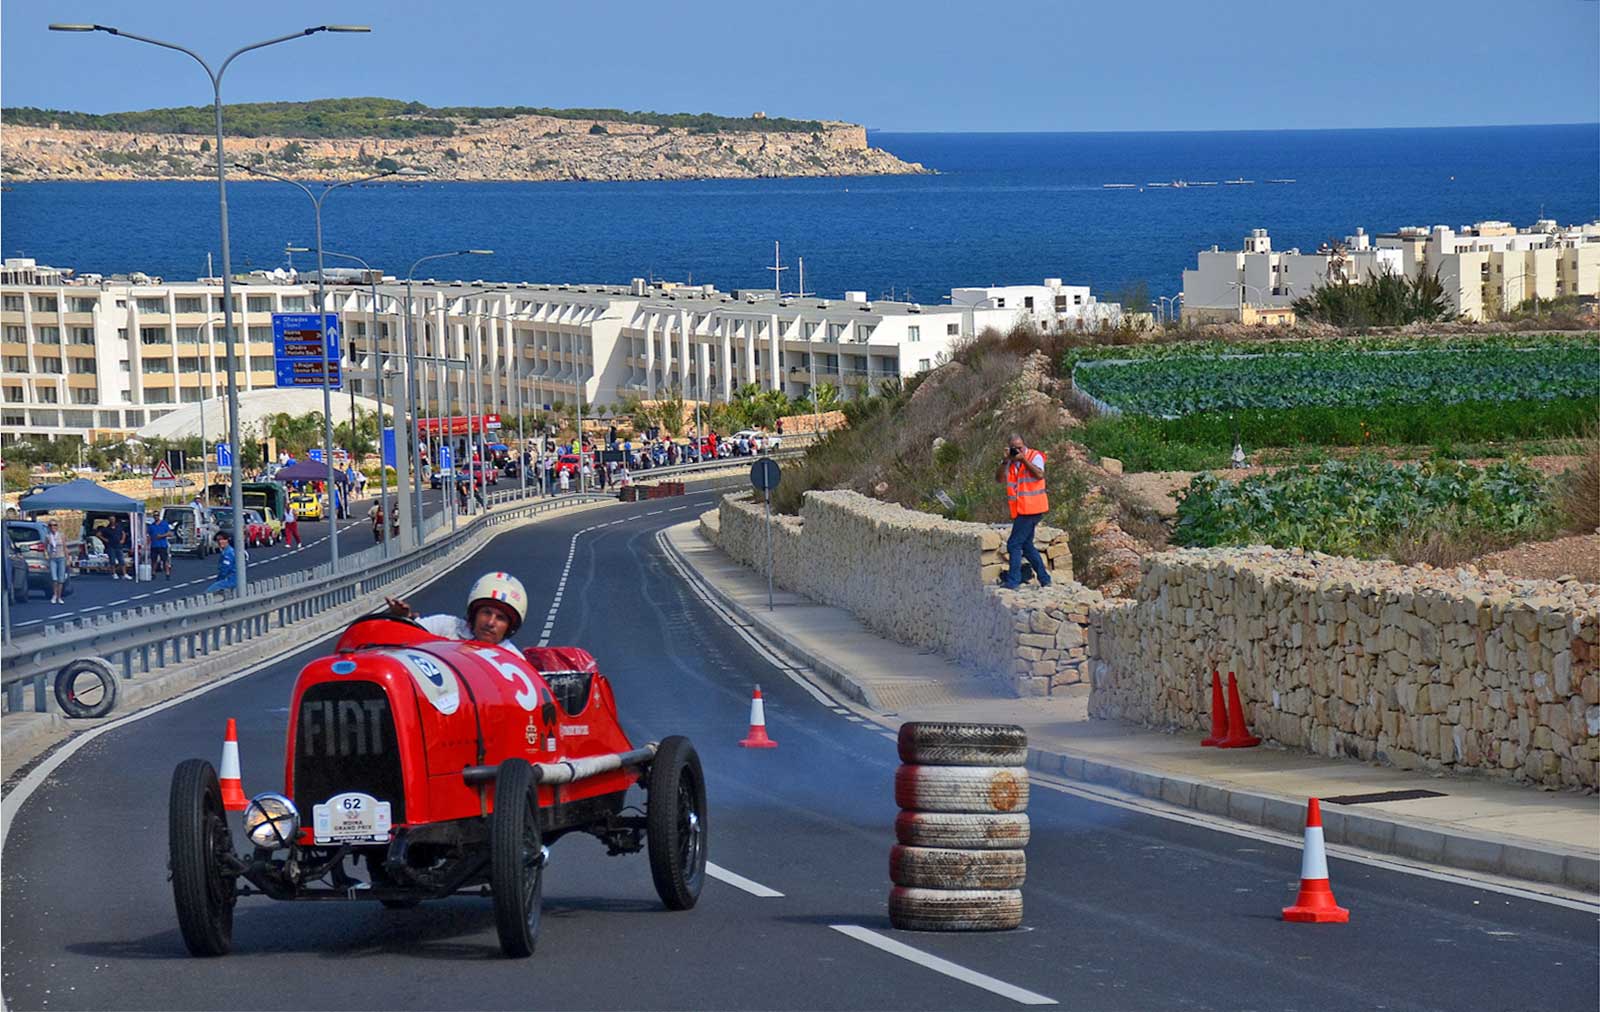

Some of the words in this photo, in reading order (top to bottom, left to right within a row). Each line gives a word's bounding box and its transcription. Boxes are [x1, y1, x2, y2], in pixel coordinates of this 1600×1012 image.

[474, 648, 538, 711] 5
[303, 699, 385, 757] FIAT
[343, 798, 361, 810] 62
